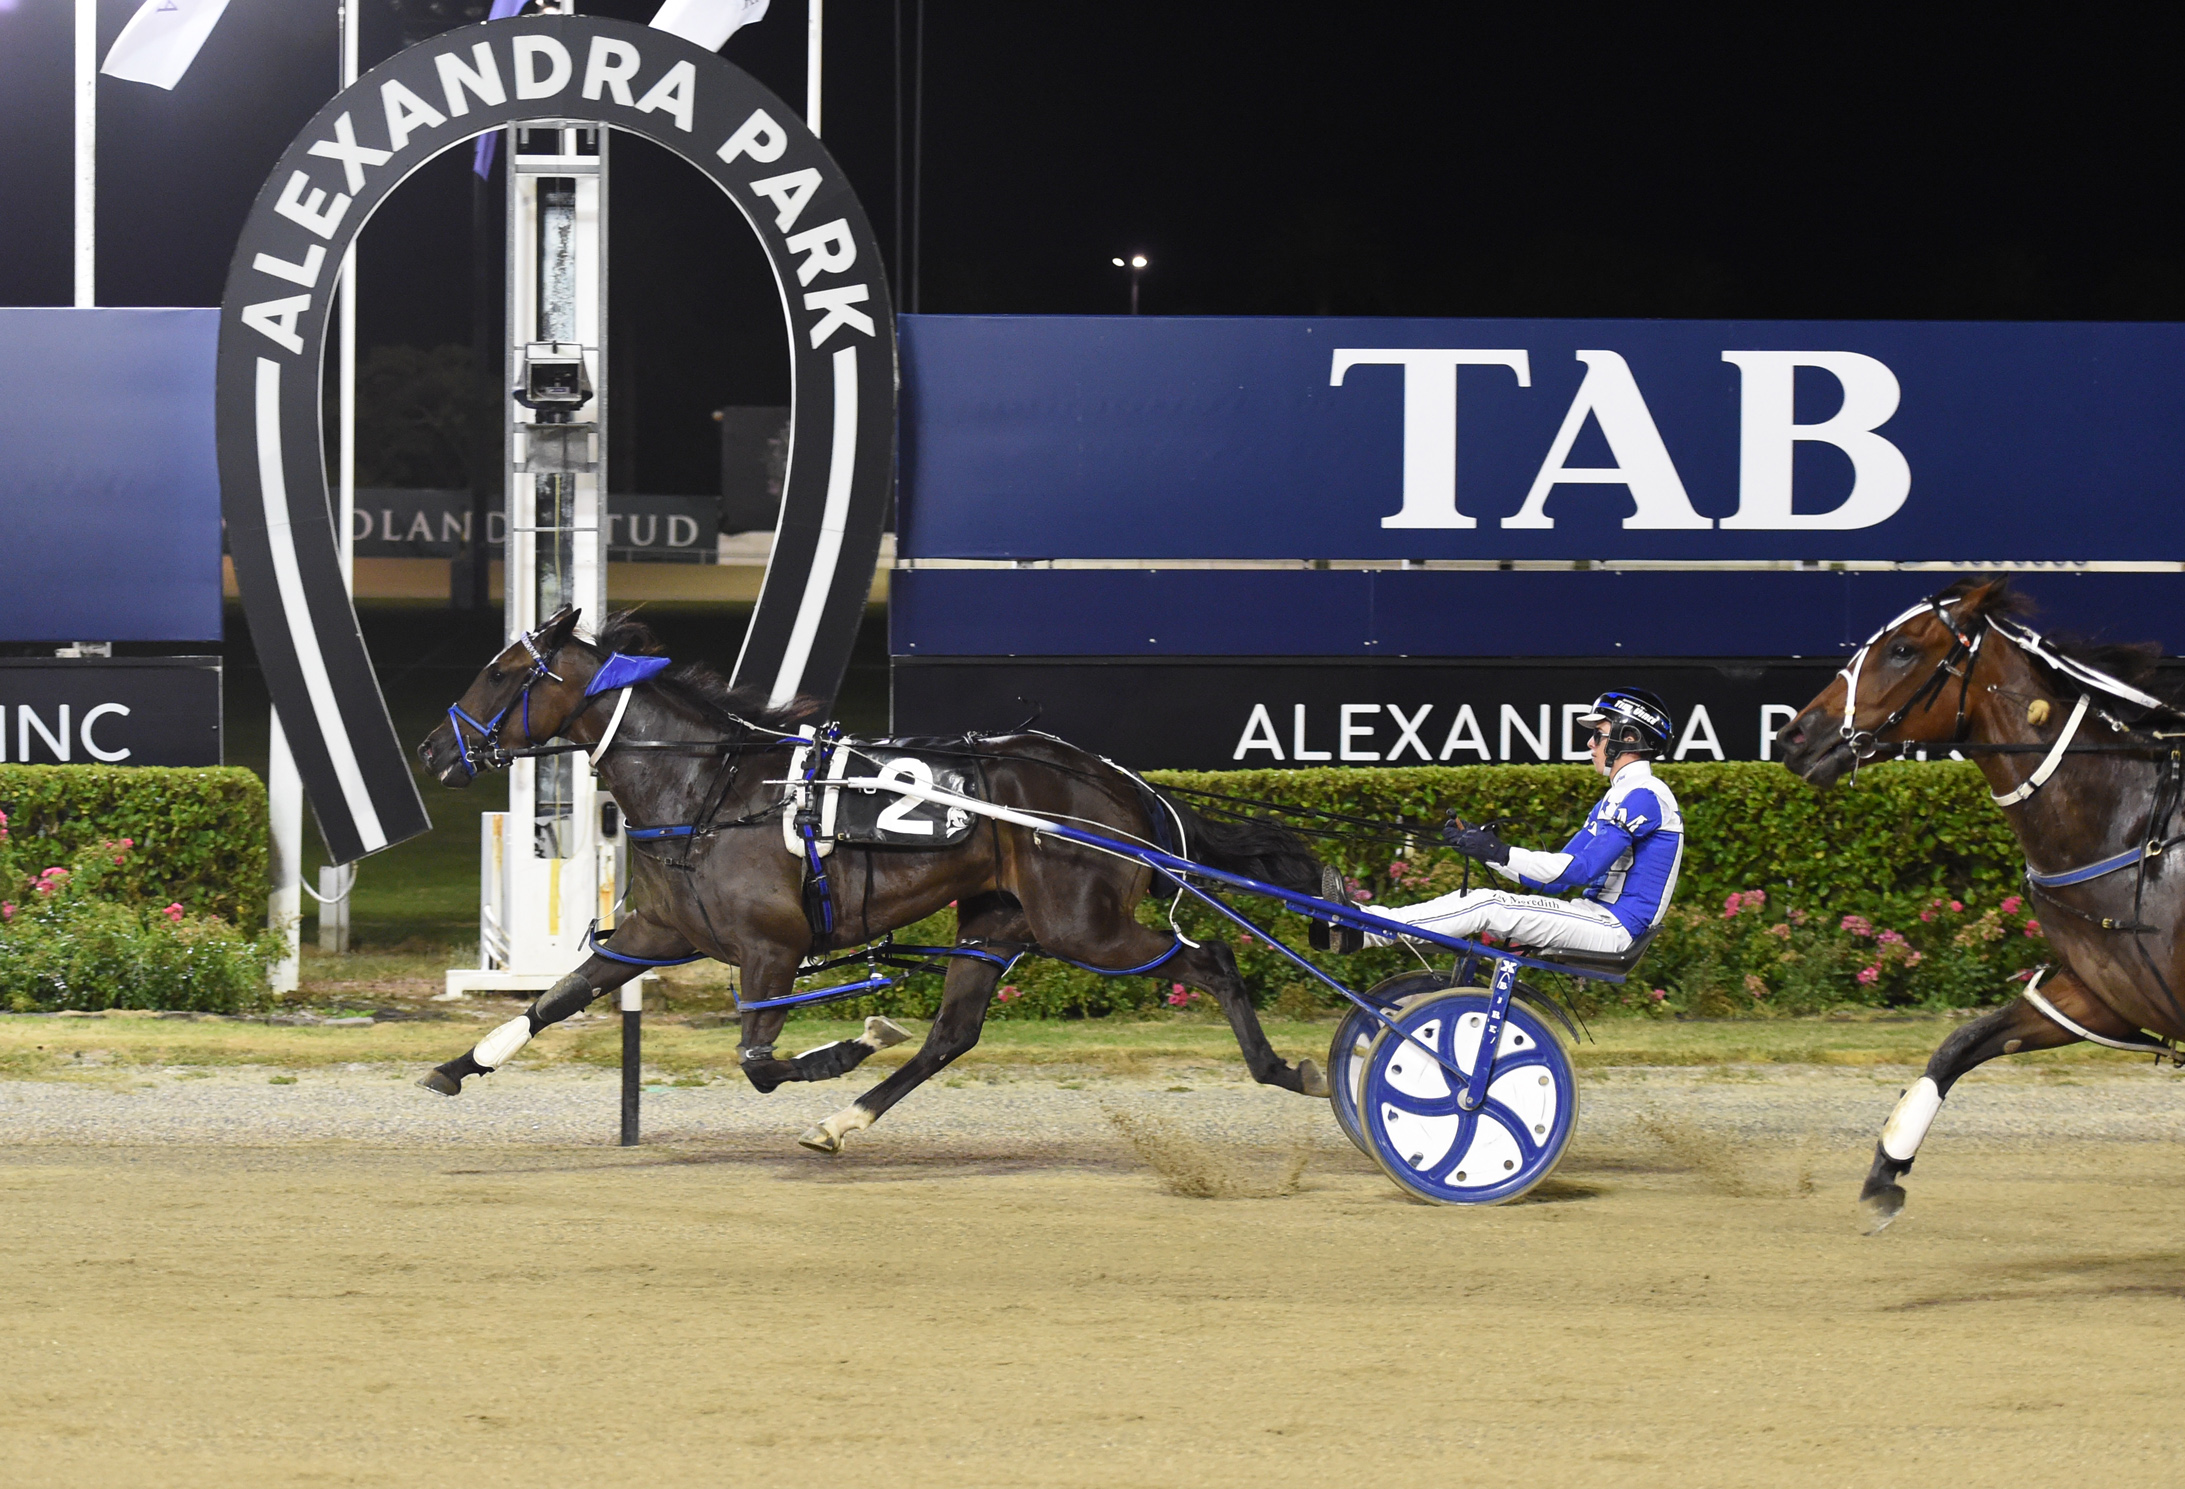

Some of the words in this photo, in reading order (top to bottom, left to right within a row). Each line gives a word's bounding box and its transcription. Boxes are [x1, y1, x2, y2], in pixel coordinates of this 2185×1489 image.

[241, 35, 696, 355] ALEXANDRA
[716, 108, 876, 350] PARK
[1329, 348, 1911, 530] TAB
[606, 513, 700, 547] TUD
[1232, 703, 1725, 765] ALEXANDA
[876, 757, 934, 836] 2
